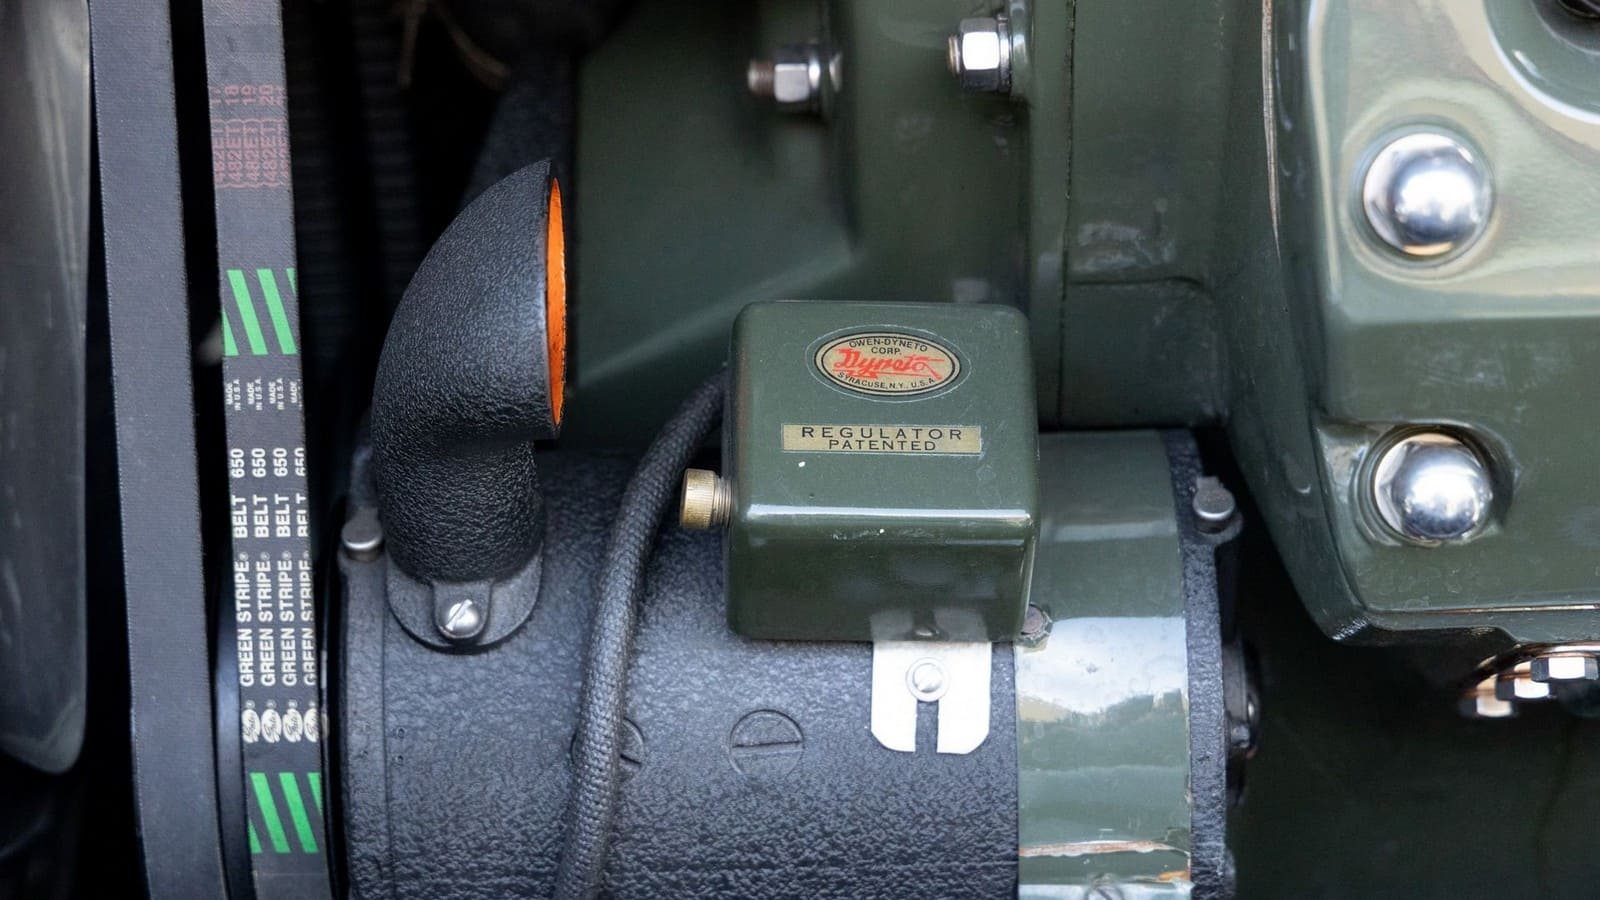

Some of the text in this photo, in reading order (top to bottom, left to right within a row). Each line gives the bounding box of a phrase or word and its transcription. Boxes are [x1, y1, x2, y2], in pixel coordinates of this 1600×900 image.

[849, 336, 928, 352] OWEN-DYNETO
[871, 346, 902, 356] CORP.
[832, 348, 944, 380] Dyneto
[225, 383, 233, 404] MADE
[247, 382, 255, 405] MADE
[269, 381, 277, 404] MADE
[290, 381, 298, 403] MADE
[234, 402, 241, 411] IN
[255, 402, 263, 411] IN
[277, 401, 285, 410] IN
[802, 426, 962, 440] REGULATOR
[829, 439, 936, 451] PATENTED
[230, 448, 245, 478] 650
[251, 448, 267, 478] 650
[273, 447, 288, 477] 650
[231, 495, 248, 538] BELT
[252, 494, 270, 538] BELT
[274, 493, 291, 537] BELT
[237, 628, 254, 687] GREEN
[258, 628, 276, 687] GREEN
[280, 628, 297, 686] GREEN
[301, 628, 317, 685] GREEN
